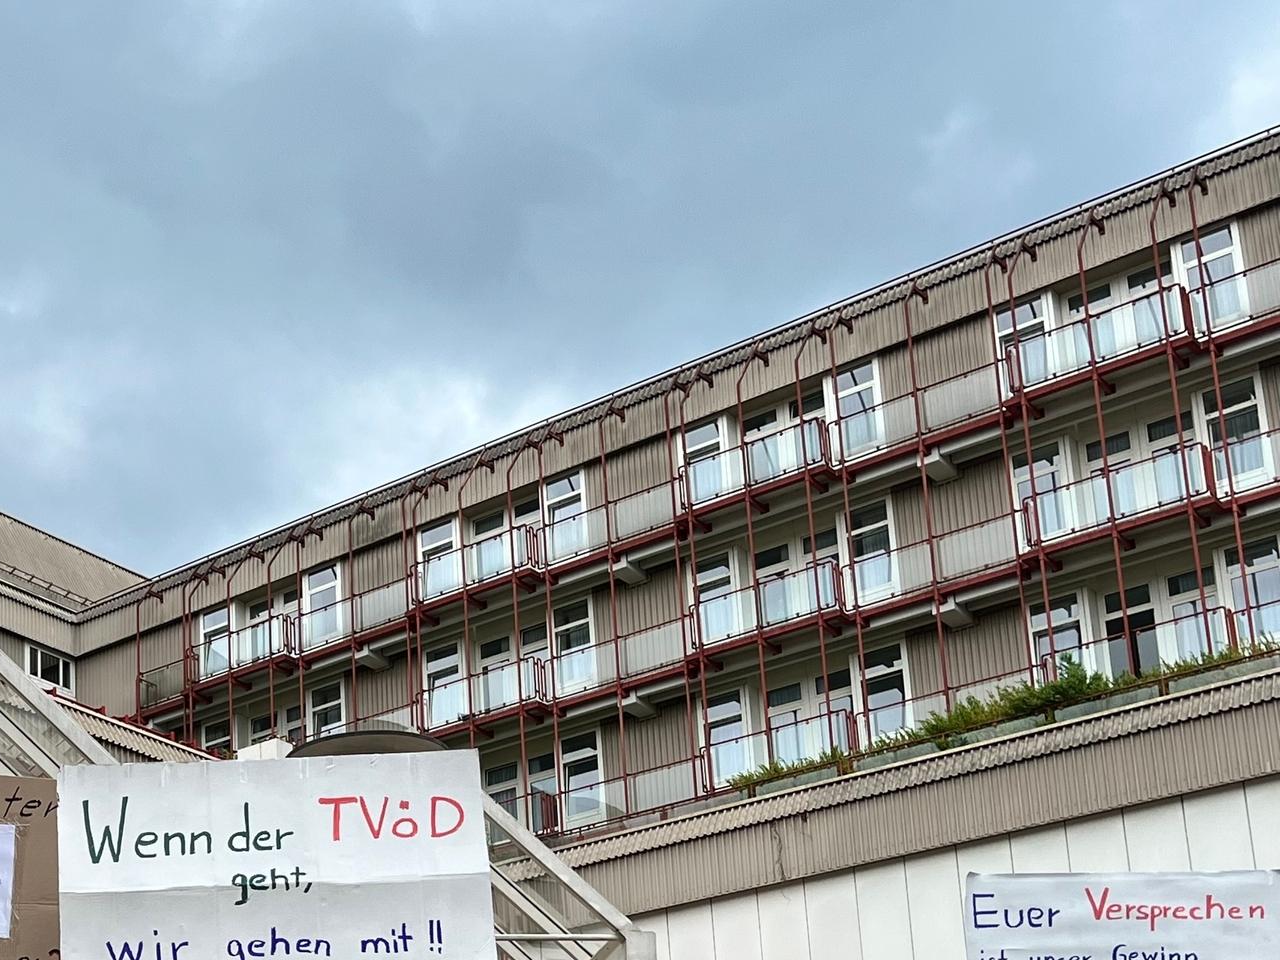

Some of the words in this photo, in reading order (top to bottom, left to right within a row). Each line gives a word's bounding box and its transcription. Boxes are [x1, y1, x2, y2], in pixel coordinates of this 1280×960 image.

[82, 796, 212, 864] Wenn
[228, 802, 294, 852] der
[319, 796, 465, 841] TVöD
[231, 866, 313, 905] geht,
[972, 893, 1061, 929] Euer
[1085, 887, 1265, 931] Versprechen
[360, 923, 413, 955] mit
